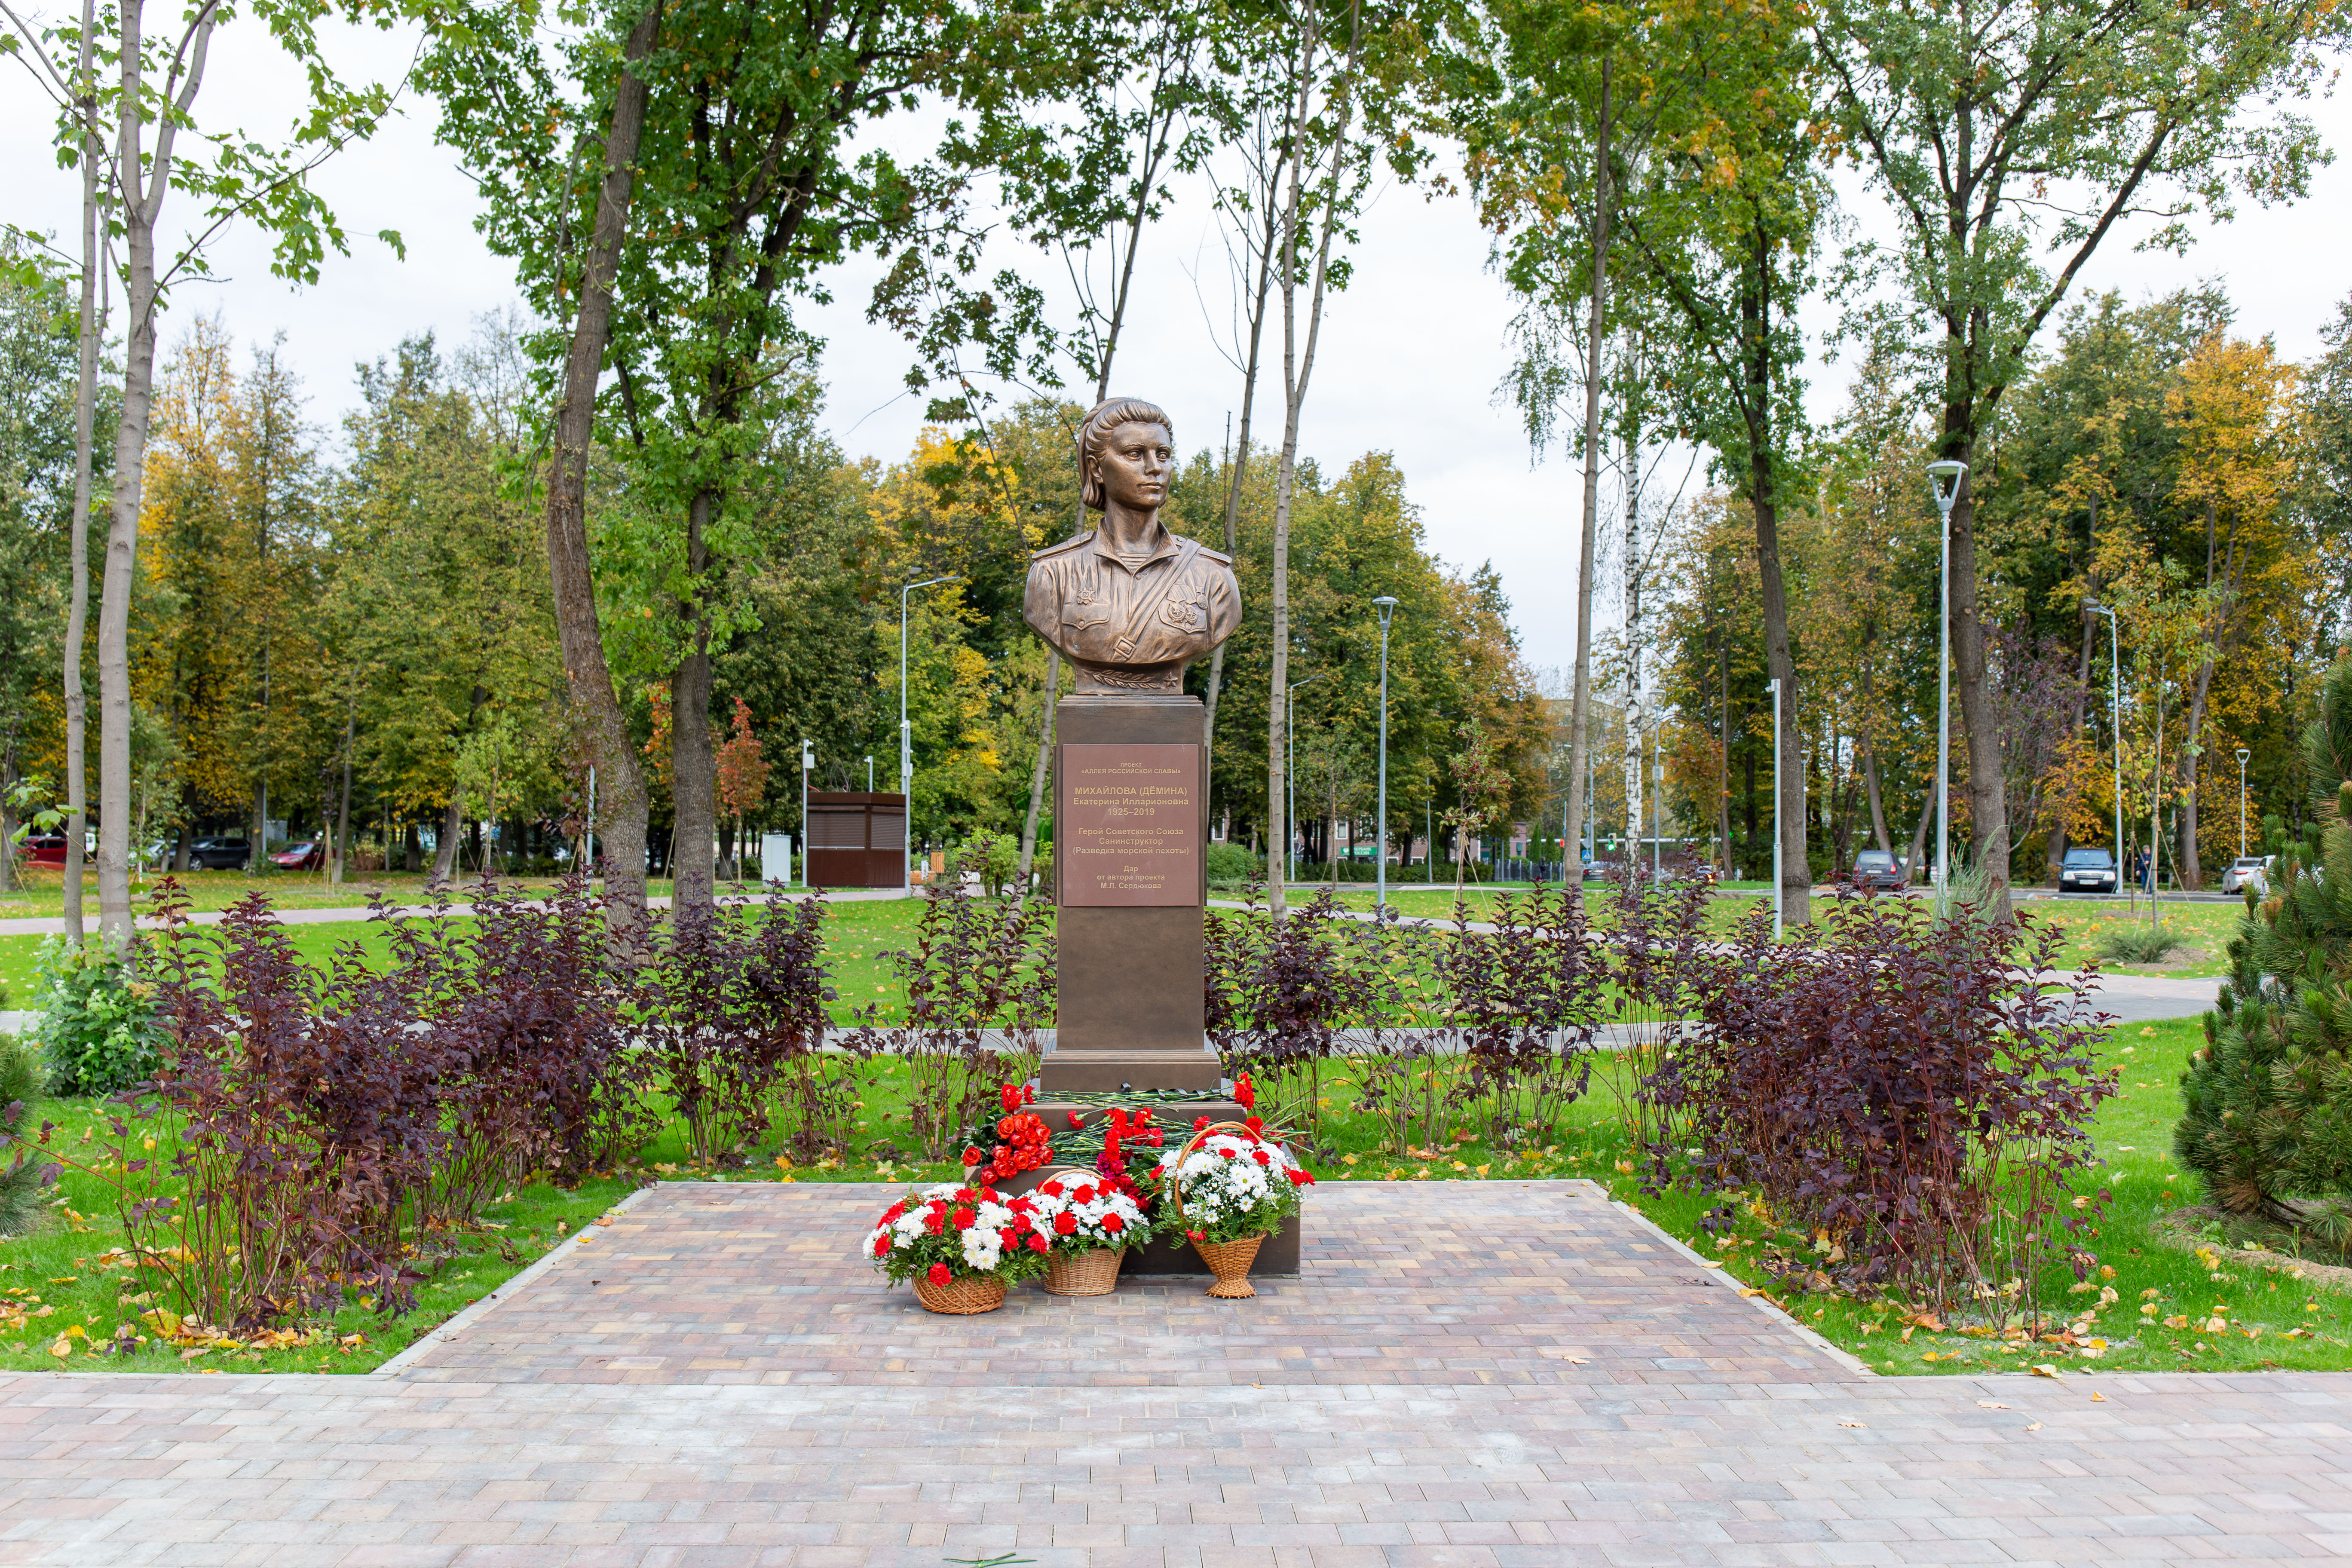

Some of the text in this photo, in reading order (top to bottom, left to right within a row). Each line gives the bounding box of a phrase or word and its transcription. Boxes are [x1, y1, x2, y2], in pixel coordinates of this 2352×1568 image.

[1075, 785, 1187, 797] МИХАЙЛОВА (ДЁМИНА)
[1073, 798, 1189, 807] Екатерина Илларионовна
[1078, 827, 1103, 836] Герой
[1099, 837, 1163, 846] Санинструктор
[1072, 846, 1189, 855] (Разведка морской пехоты)
[1118, 882, 1161, 890] Сердюкова
